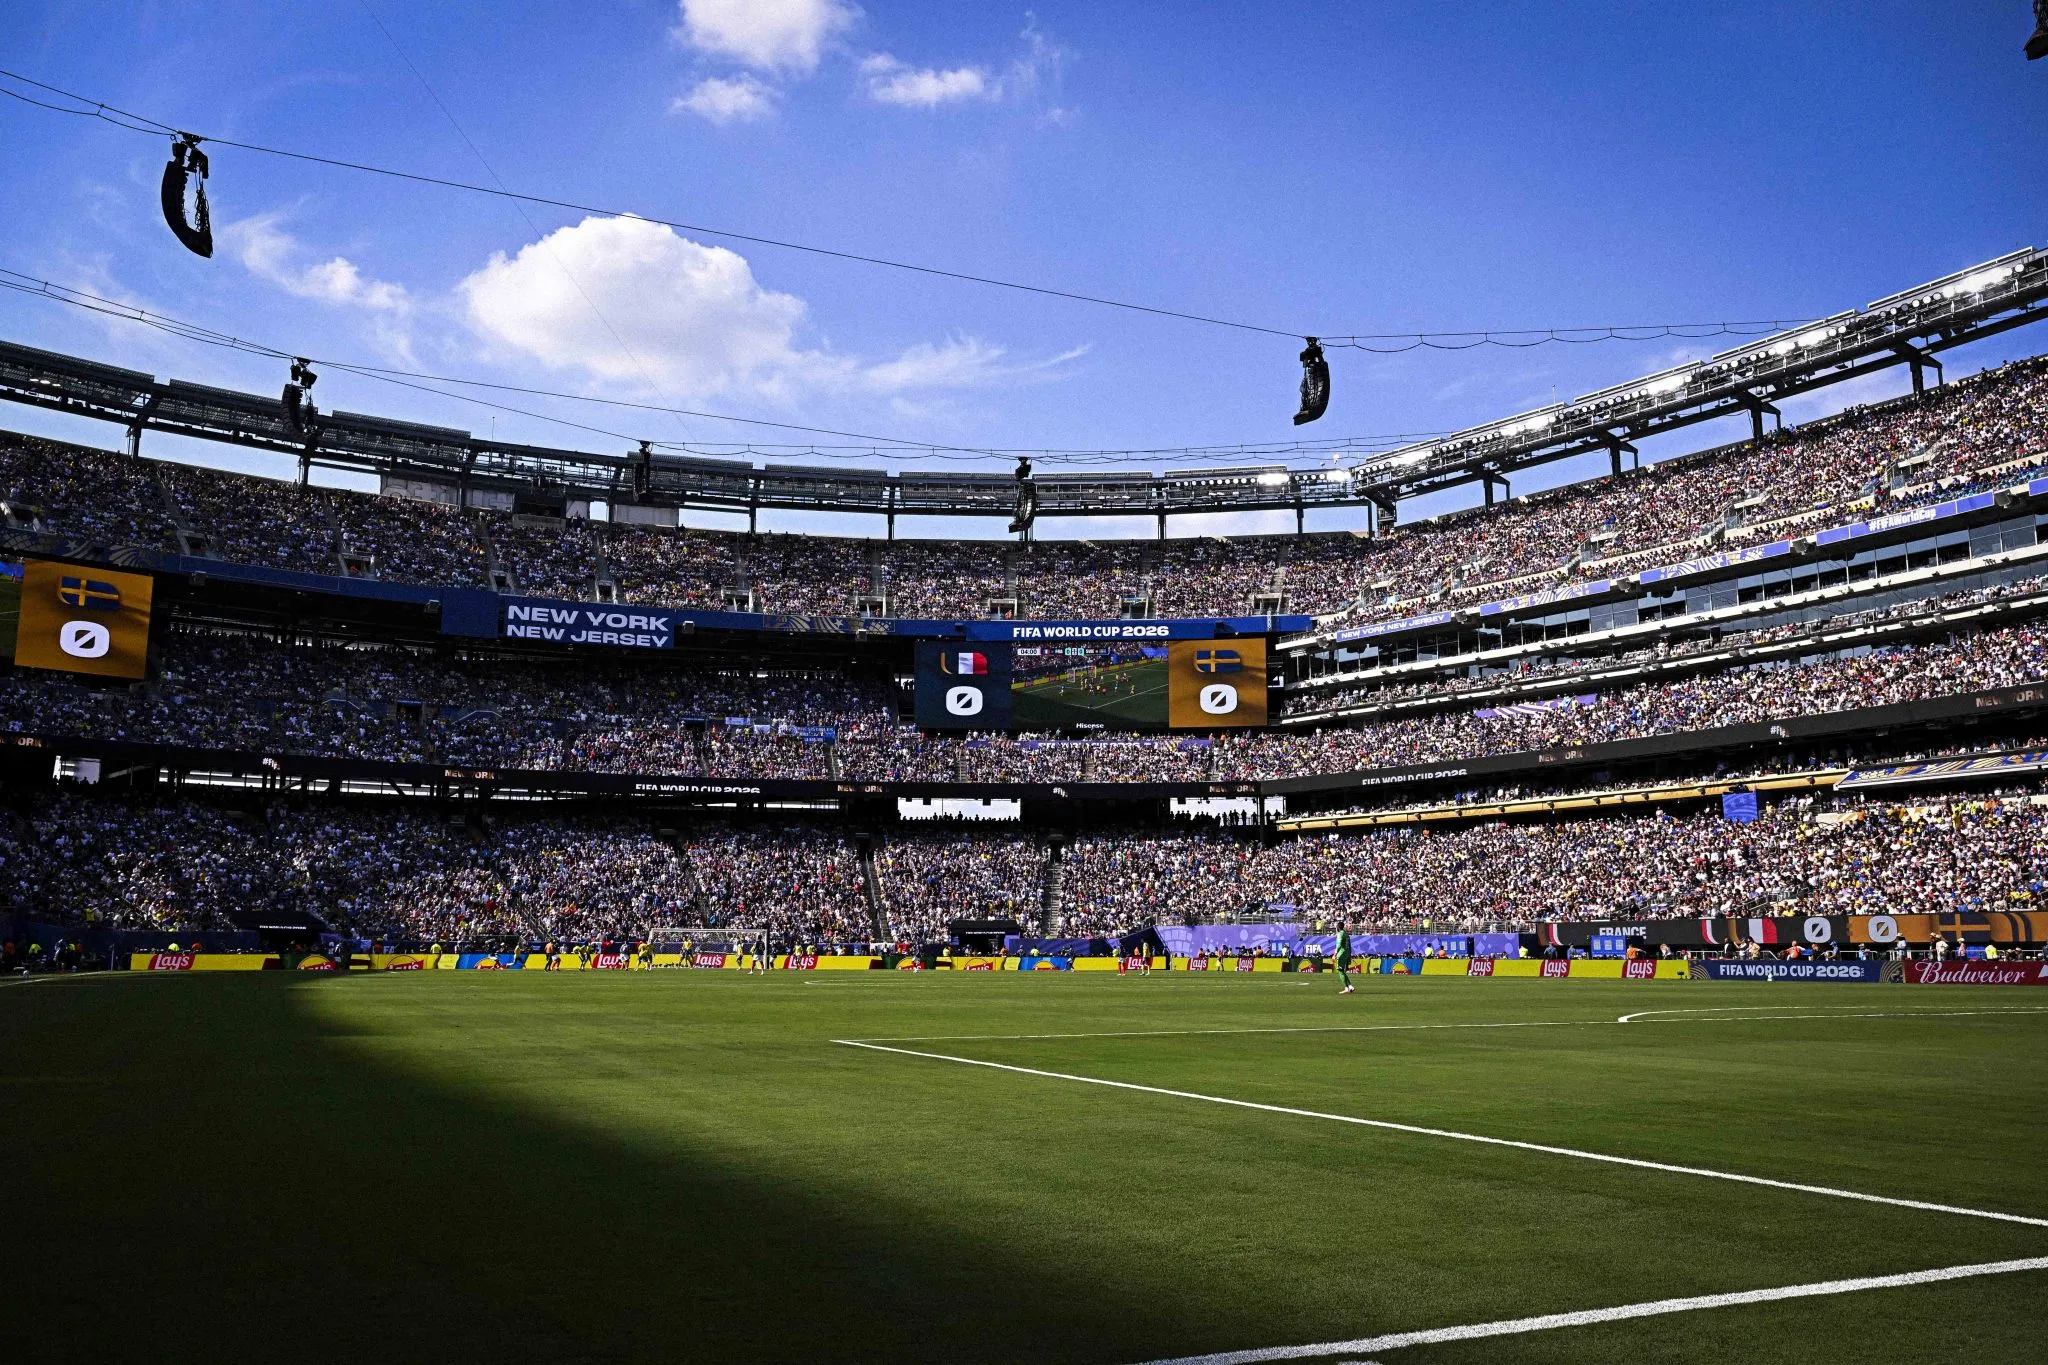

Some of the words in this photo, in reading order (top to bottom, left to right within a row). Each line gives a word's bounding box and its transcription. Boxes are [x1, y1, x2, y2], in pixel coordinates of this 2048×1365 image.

[1869, 508, 1936, 531] #FIFAWorldCup
[507, 605, 579, 625] NEW
[585, 611, 669, 631] YORK
[1341, 629, 1361, 639] NEW
[1361, 624, 1386, 635] YORK
[1387, 620, 1407, 631] NEW
[1408, 615, 1445, 627] JERSEY
[60, 621, 110, 658] 0
[506, 625, 566, 640] NEW
[570, 630, 669, 647] JERSEY
[1013, 626, 1041, 637] FIFA
[1043, 626, 1091, 637] WORLD
[1093, 626, 1119, 637] CUP
[1122, 625, 1170, 636] 2026
[946, 686, 983, 716] 0
[1200, 684, 1238, 714] 0
[2015, 689, 2044, 702] ORK
[1599, 927, 1648, 939] FRANCE
[1804, 916, 1832, 943] 0
[1868, 916, 1898, 943] 0
[1306, 945, 1322, 954] FIFA
[154, 954, 191, 970] Lay's
[1189, 958, 1207, 970] Lay's
[1239, 957, 1253, 970] Lay's
[1470, 960, 1491, 976] Lay's
[1544, 960, 1567, 977] Lay's
[1626, 960, 1653, 978] Lay's
[1719, 965, 1744, 975] FIFA
[1745, 965, 1791, 976] WORLD
[1793, 965, 1817, 977] CUP
[1816, 965, 1861, 978] 2026
[1914, 961, 2026, 983] Budweiser
